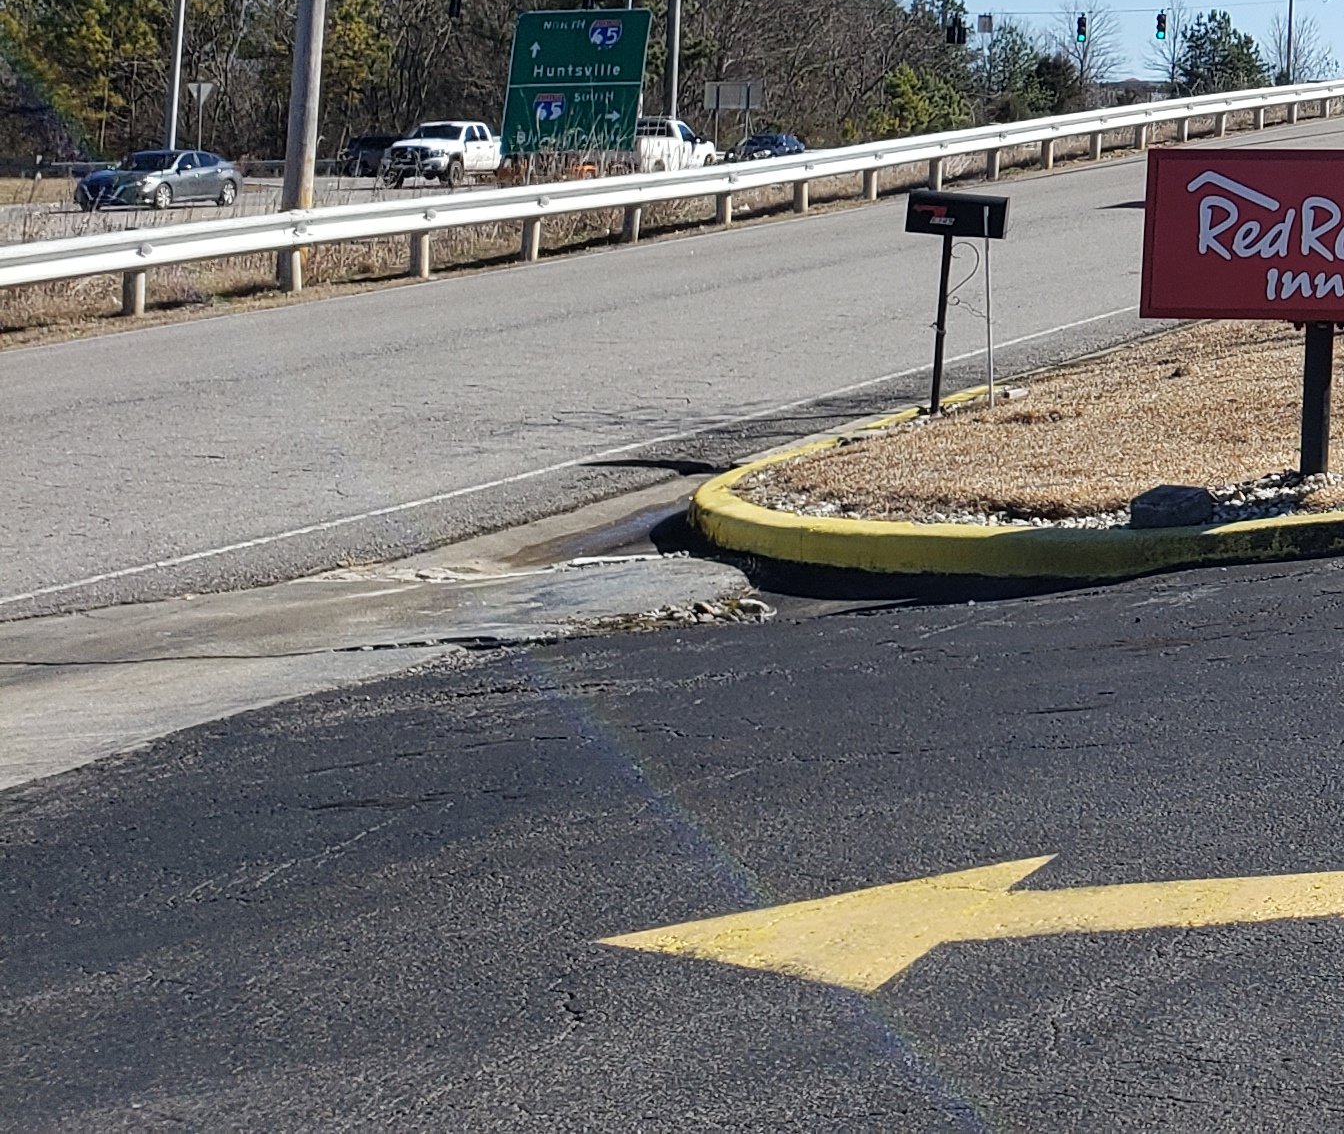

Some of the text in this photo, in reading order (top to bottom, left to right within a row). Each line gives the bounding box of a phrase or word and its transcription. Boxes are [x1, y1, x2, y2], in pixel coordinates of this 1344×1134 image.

[590, 27, 619, 45] 65
[533, 63, 621, 78] Huntsville
[536, 101, 563, 121] 65
[1199, 195, 1296, 261] Red
